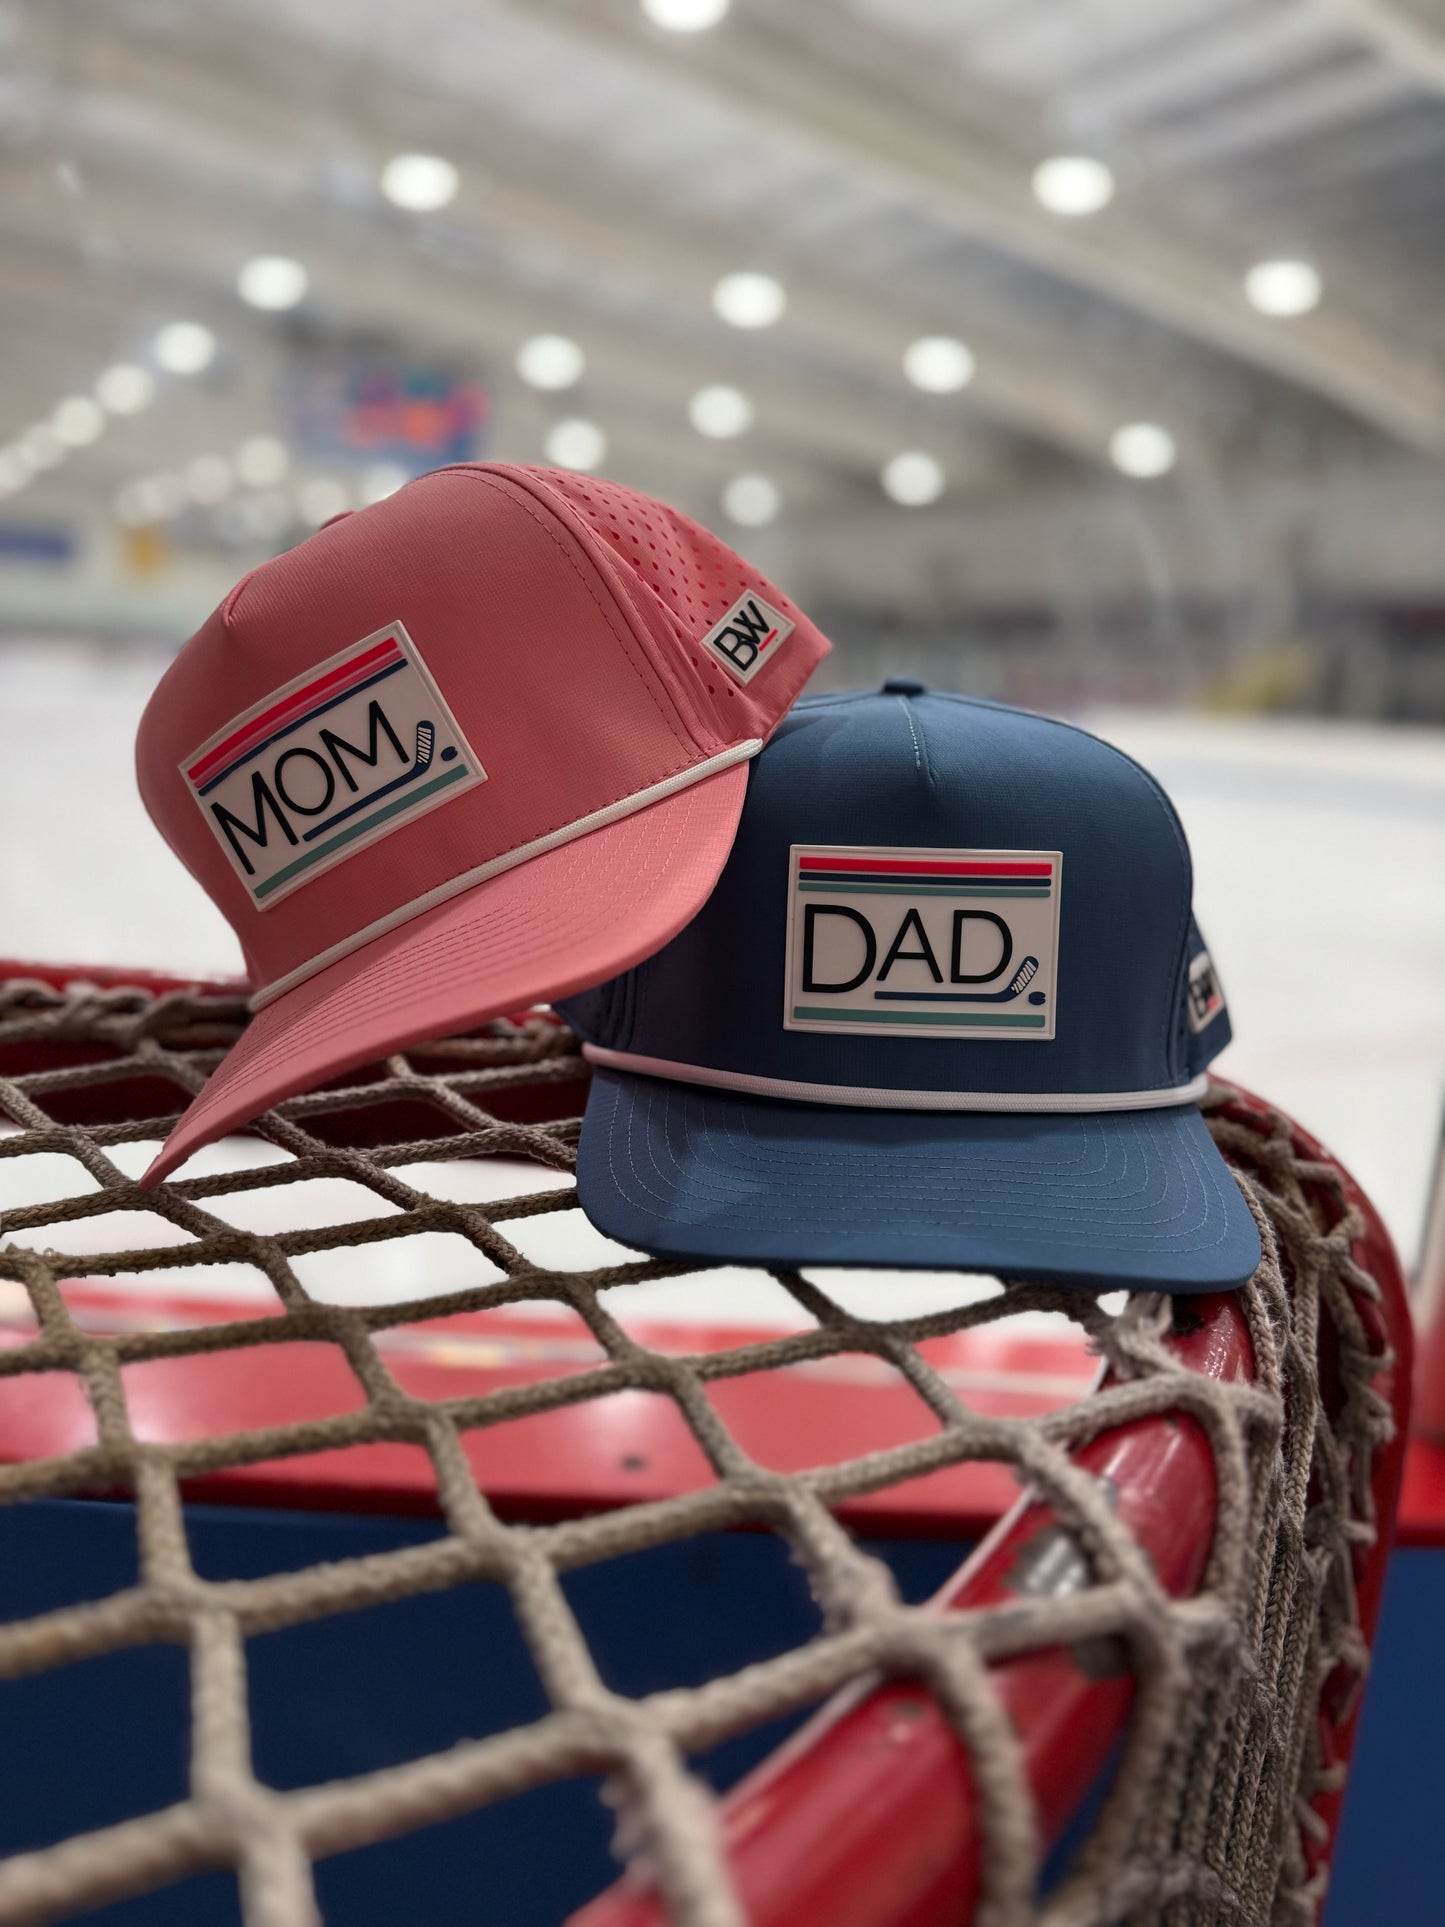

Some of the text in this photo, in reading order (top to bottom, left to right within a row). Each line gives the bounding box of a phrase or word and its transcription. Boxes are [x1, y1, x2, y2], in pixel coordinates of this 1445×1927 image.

[713, 600, 770, 671] BW
[210, 700, 410, 875] MOM
[803, 904, 1013, 993] DAD
